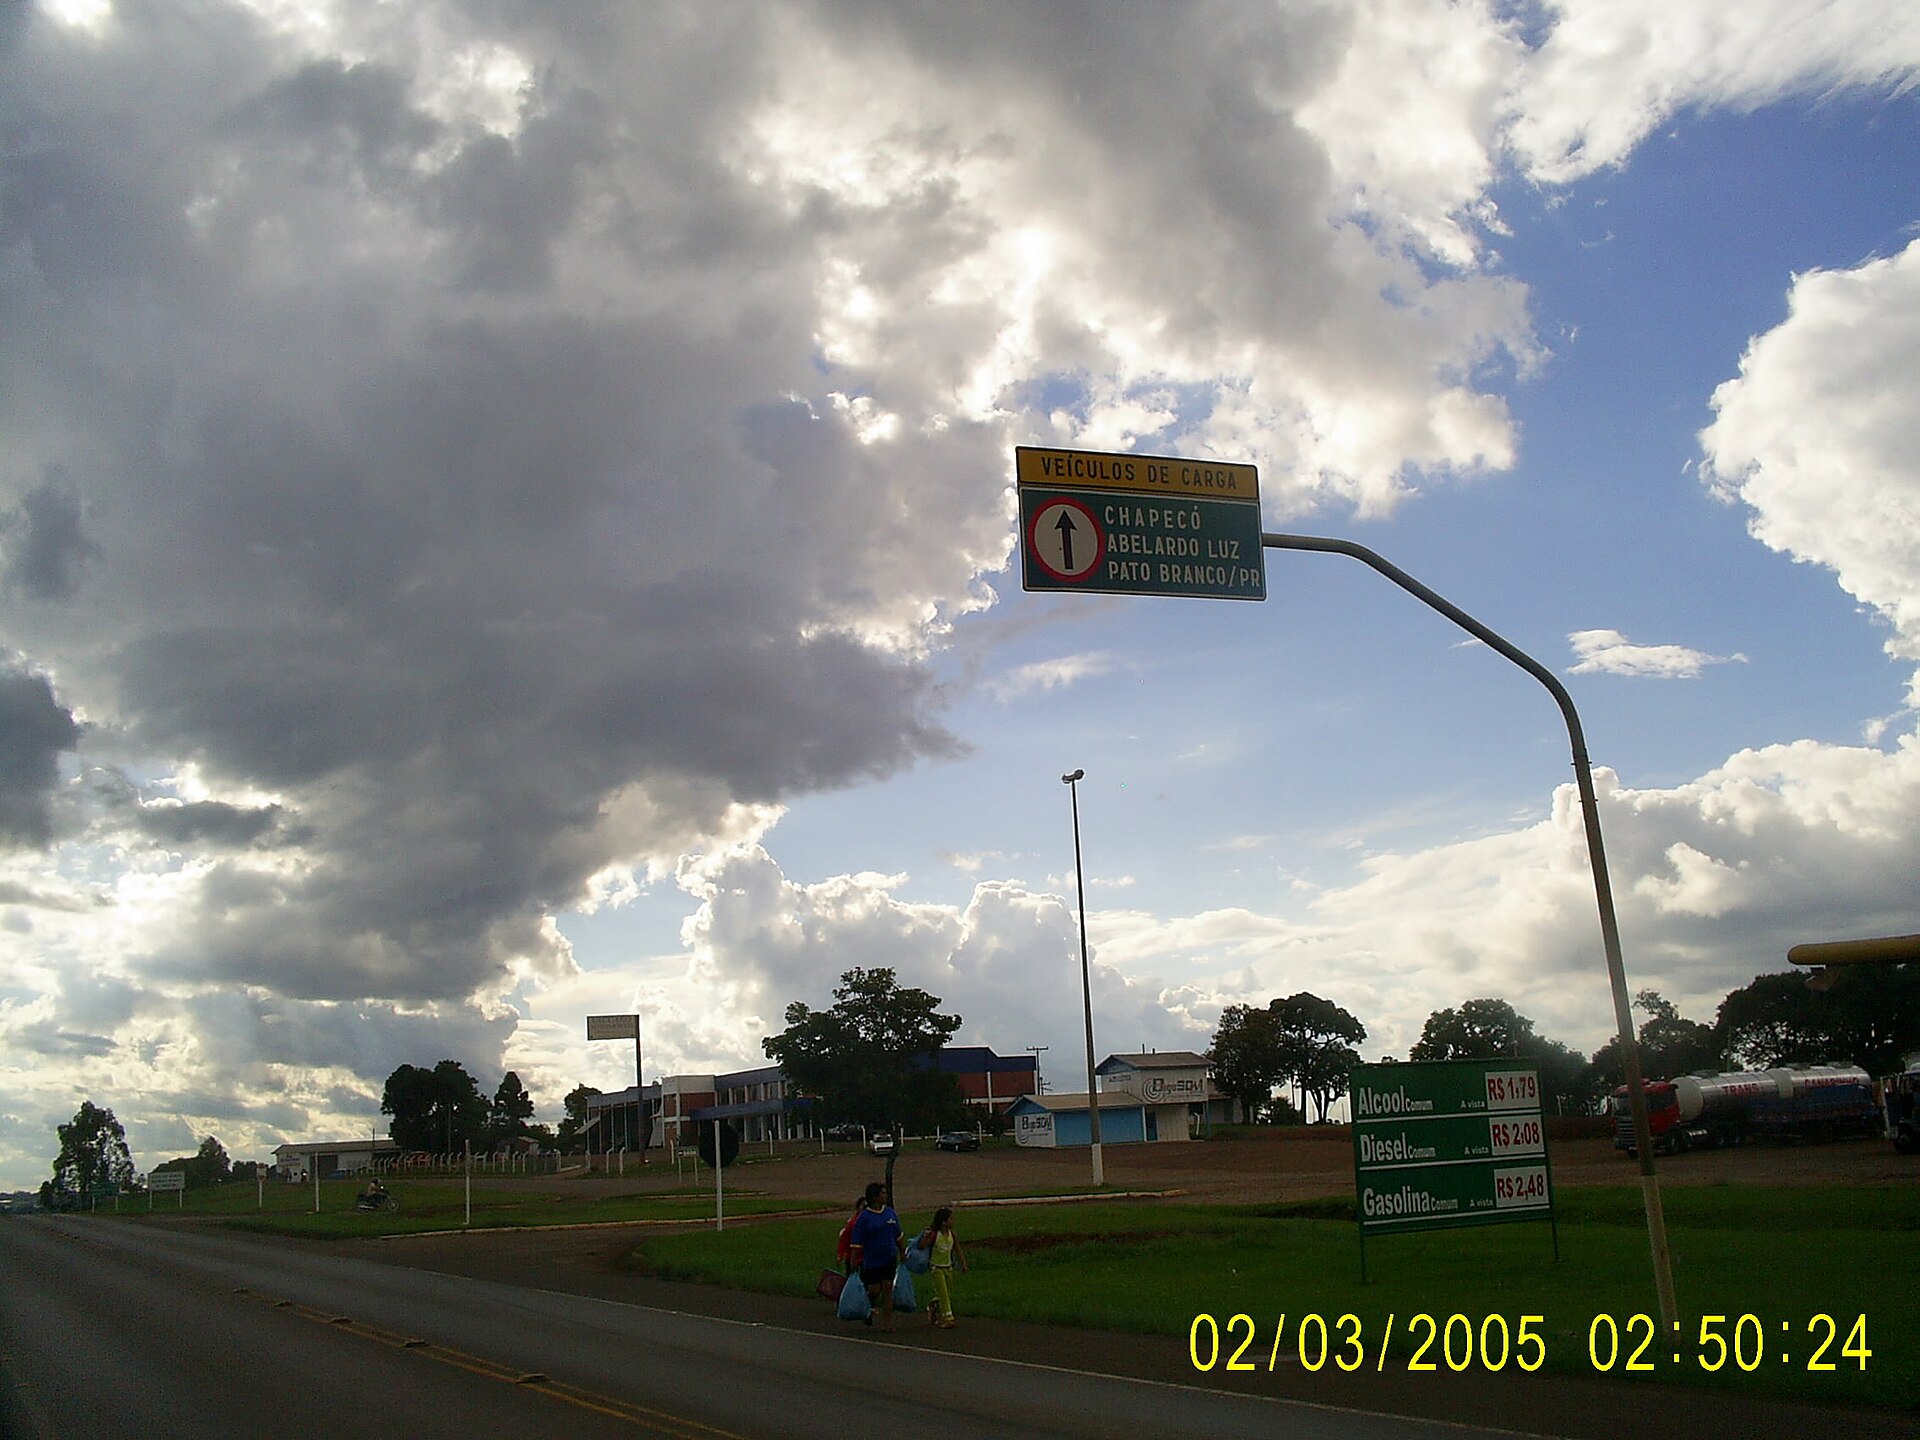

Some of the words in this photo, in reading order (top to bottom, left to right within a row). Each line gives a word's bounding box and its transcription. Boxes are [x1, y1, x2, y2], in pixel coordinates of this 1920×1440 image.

[1041, 454, 1135, 481] VEÍCULOS
[1148, 466, 1169, 484] DE
[1181, 468, 1237, 490] CARGA
[1104, 504, 1201, 530] CHAPECÓ
[1108, 533, 1200, 558] ABELARDO
[1208, 540, 1240, 560] LUZ
[1108, 561, 1151, 582] PATO
[1160, 563, 1260, 588] BRANCO/PR
[1358, 1085, 1405, 1115] Alcool
[1487, 1077, 1505, 1101] R$
[1722, 1083, 1759, 1096] TRANS
[1359, 1132, 1408, 1162] Diesel
[1492, 1124, 1510, 1148] R$
[1363, 1185, 1430, 1216] Gasolina
[1496, 1177, 1514, 1199] R$
[1516, 1174, 1544, 1200] 2,48
